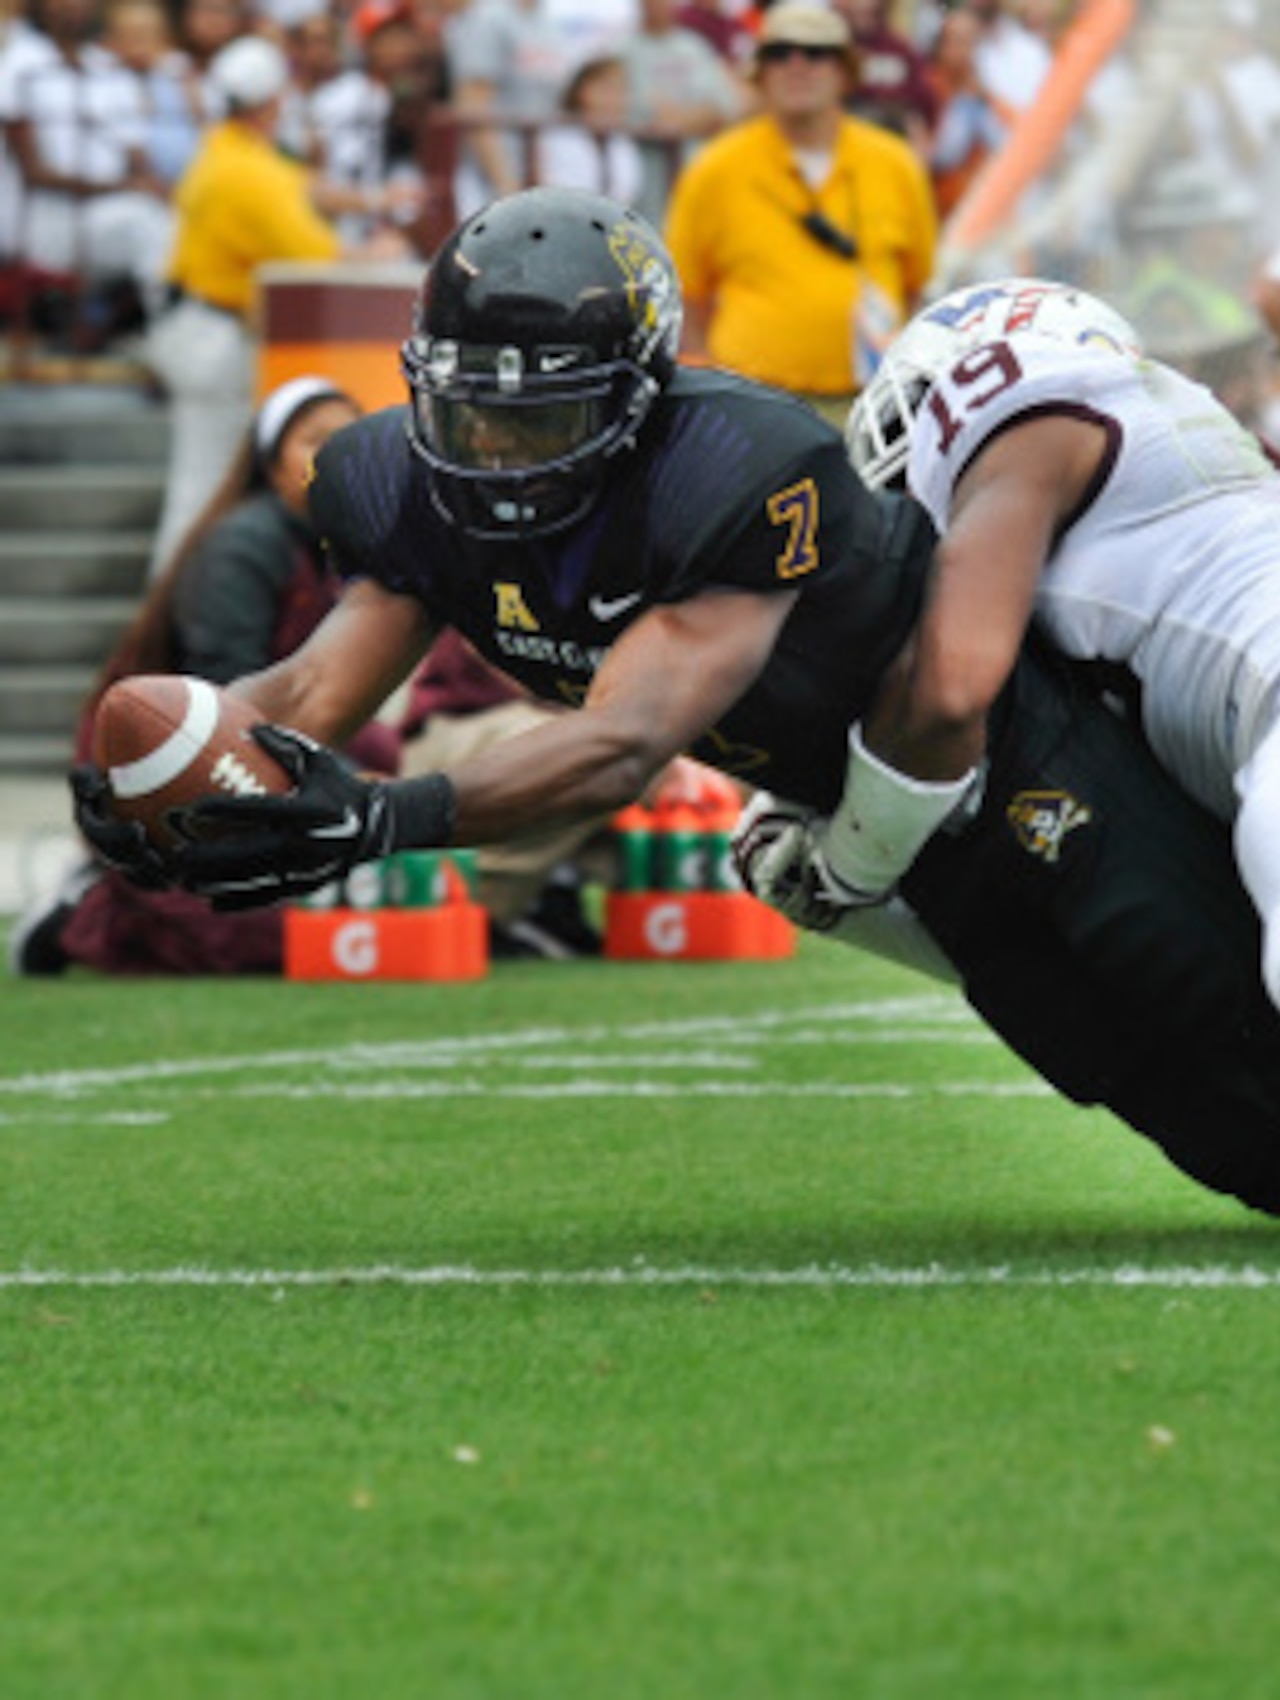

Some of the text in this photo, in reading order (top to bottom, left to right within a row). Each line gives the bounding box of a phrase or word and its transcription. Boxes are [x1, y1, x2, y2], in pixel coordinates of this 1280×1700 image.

[928, 340, 1023, 456] 19
[766, 477, 819, 579] 7
[492, 581, 541, 632] A
[331, 921, 379, 975] G
[644, 903, 687, 954] G
